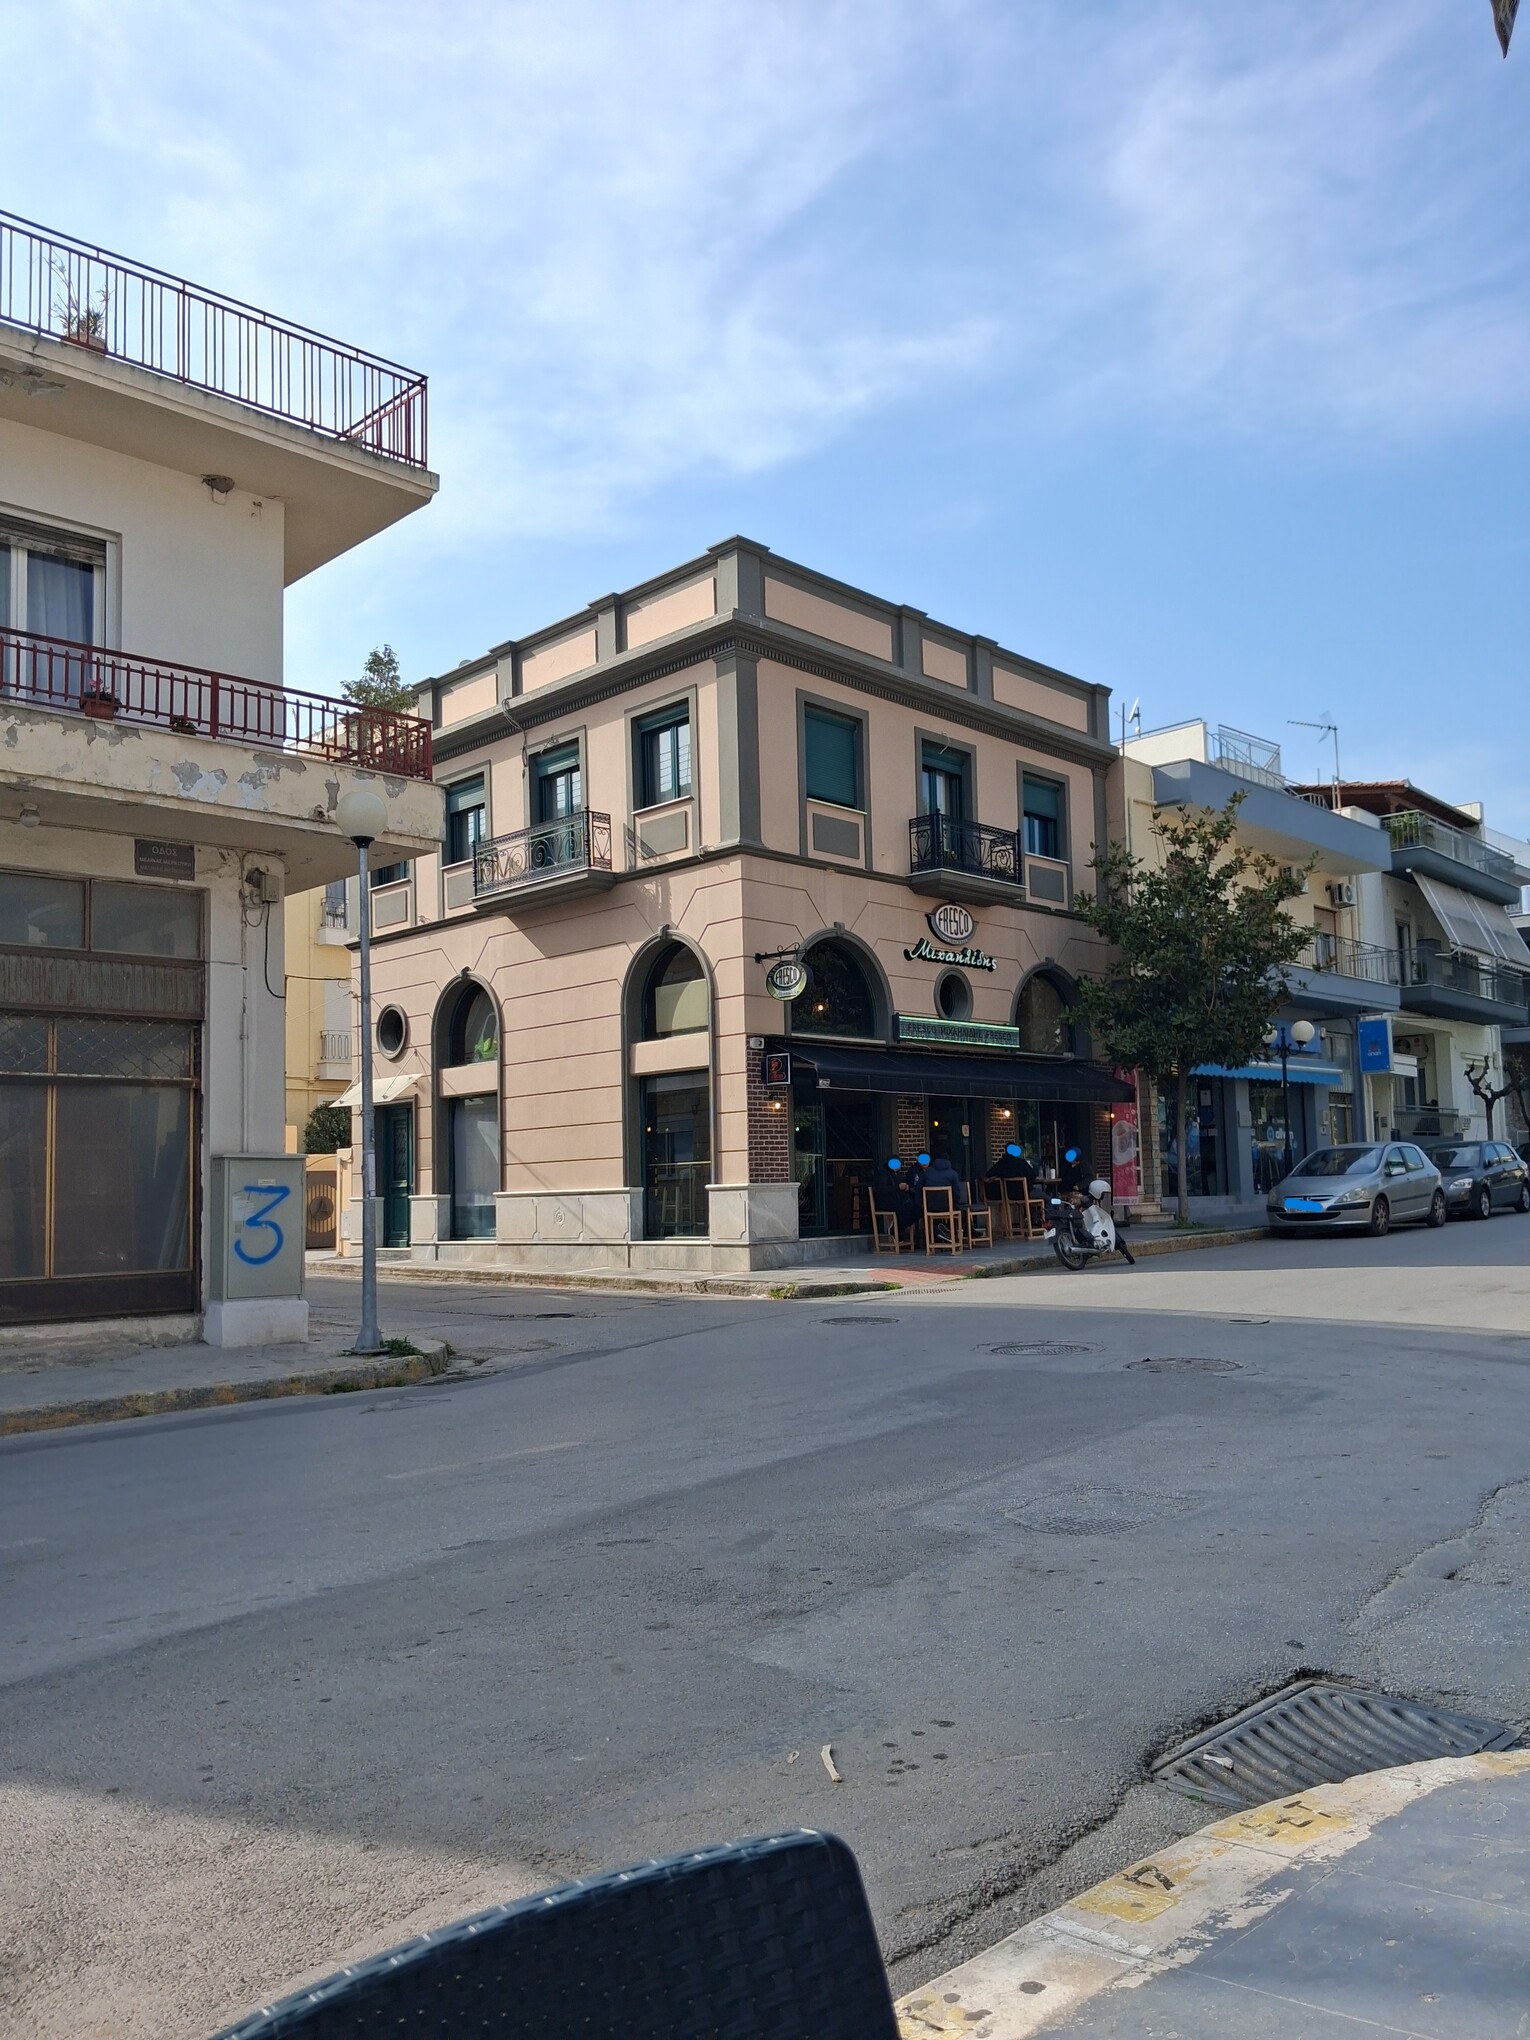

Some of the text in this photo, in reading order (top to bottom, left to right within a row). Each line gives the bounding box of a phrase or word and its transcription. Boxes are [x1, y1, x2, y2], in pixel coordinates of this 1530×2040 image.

[152, 846, 178, 857] ΟΔΟΣ
[938, 907, 969, 936] FRESCO
[775, 966, 799, 985] FRESCO
[908, 1023, 937, 1034] FRESCO
[985, 1030, 1012, 1040] FRESCO
[234, 1186, 290, 1265] 3
